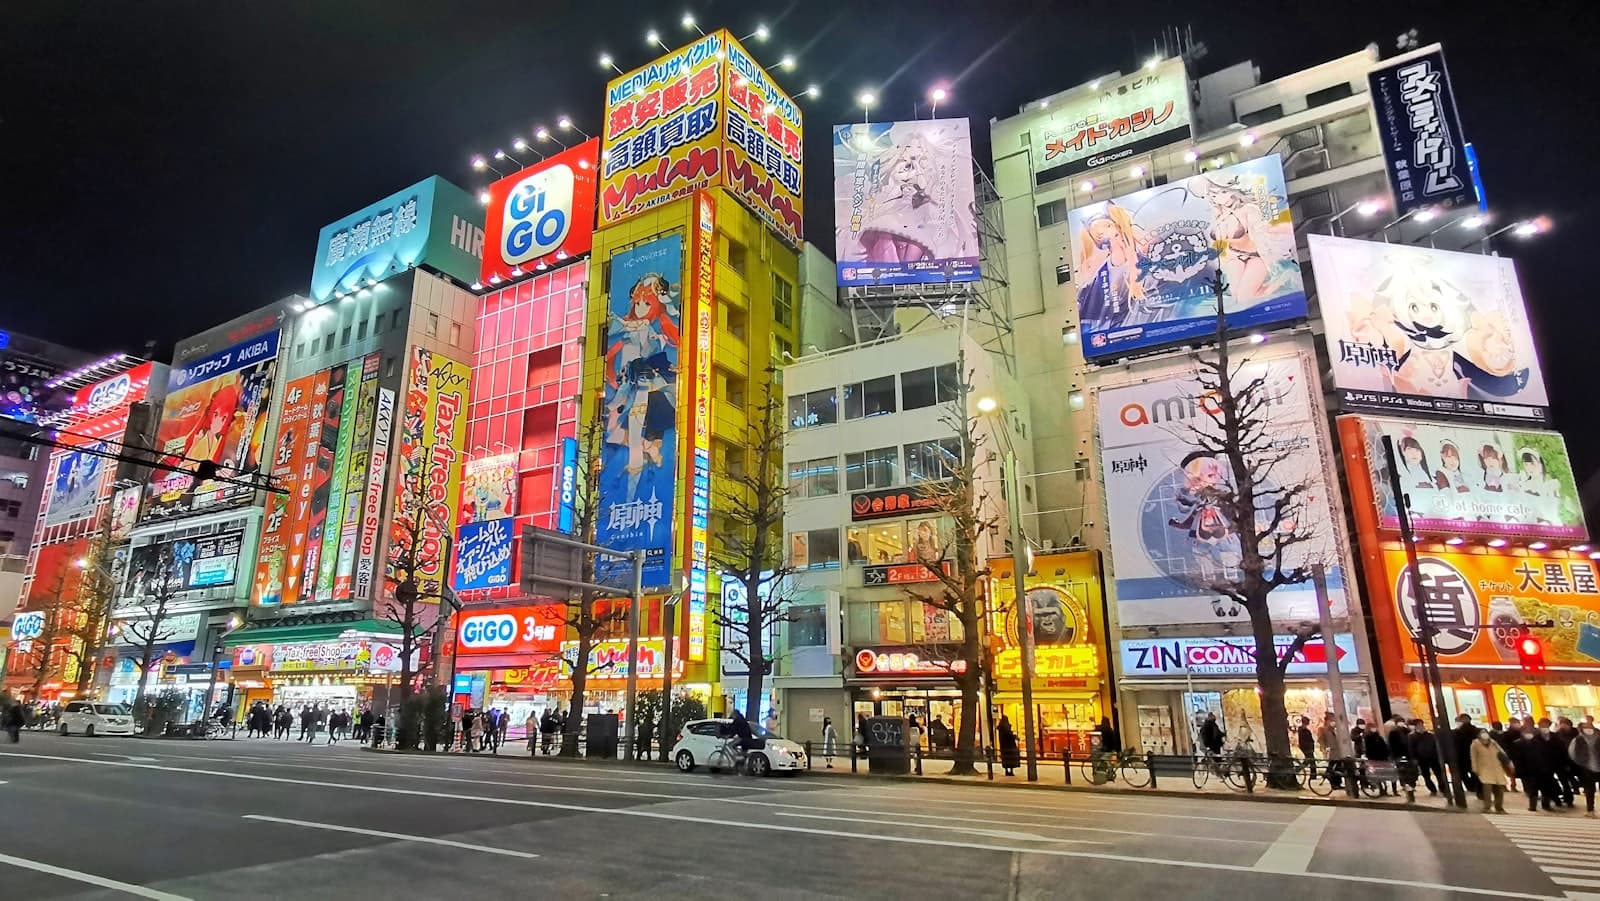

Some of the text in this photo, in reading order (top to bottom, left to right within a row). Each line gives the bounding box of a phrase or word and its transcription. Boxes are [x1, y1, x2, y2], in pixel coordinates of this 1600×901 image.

[609, 35, 721, 106] MEDIAリサイクル
[727, 43, 801, 128] MEDIAリサイクル
[608, 63, 721, 139] 激安販売
[728, 69, 801, 161] 激安販売
[604, 101, 718, 179] 高額買取
[1045, 99, 1174, 160] メイドカジノ
[726, 109, 800, 198] 高額買取
[602, 147, 720, 220] Mulan
[726, 149, 803, 236] Mulan
[1395, 159, 1414, 201] 秋葉原店
[509, 184, 547, 221] Gi
[612, 202, 646, 221] ムーラン
[645, 193, 671, 208] AKIBA
[734, 186, 758, 211] ムーラン
[506, 208, 565, 258] GO
[189, 353, 231, 380] ソフマップ
[237, 340, 268, 363] AKIBA
[1338, 335, 1400, 371] 原神
[429, 361, 465, 391] AKKY
[286, 386, 303, 405] 4F
[1355, 393, 1377, 402] PS5
[1382, 395, 1404, 404] PS4
[378, 391, 394, 438] AKKY
[276, 447, 292, 465] 3F
[298, 403, 323, 521] 秋葉原 Hey
[1111, 452, 1148, 477] 原神
[366, 451, 386, 514] Tax-free
[420, 391, 463, 575] Tax-free Shop
[562, 465, 573, 503] GiGO
[265, 513, 281, 533] 2F
[606, 485, 663, 541] 原神
[1456, 500, 1532, 516] at home cafe
[360, 516, 378, 556] Shop
[456, 526, 507, 575] オアシスに
[457, 519, 500, 555] ゲームの
[610, 531, 645, 541] Genshin
[889, 569, 903, 581] 2F
[1478, 580, 1514, 592] チケット
[1514, 561, 1599, 595] 大黒屋
[15, 614, 43, 636] GiGO
[464, 616, 556, 644] GiGO 3号館
[288, 647, 319, 660] Tax-free
[320, 646, 342, 658] Shop
[597, 643, 655, 665] Muln
[1128, 640, 1182, 673] ZIN
[1188, 643, 1257, 664] COMIC
[1188, 666, 1257, 674] Akihabara
